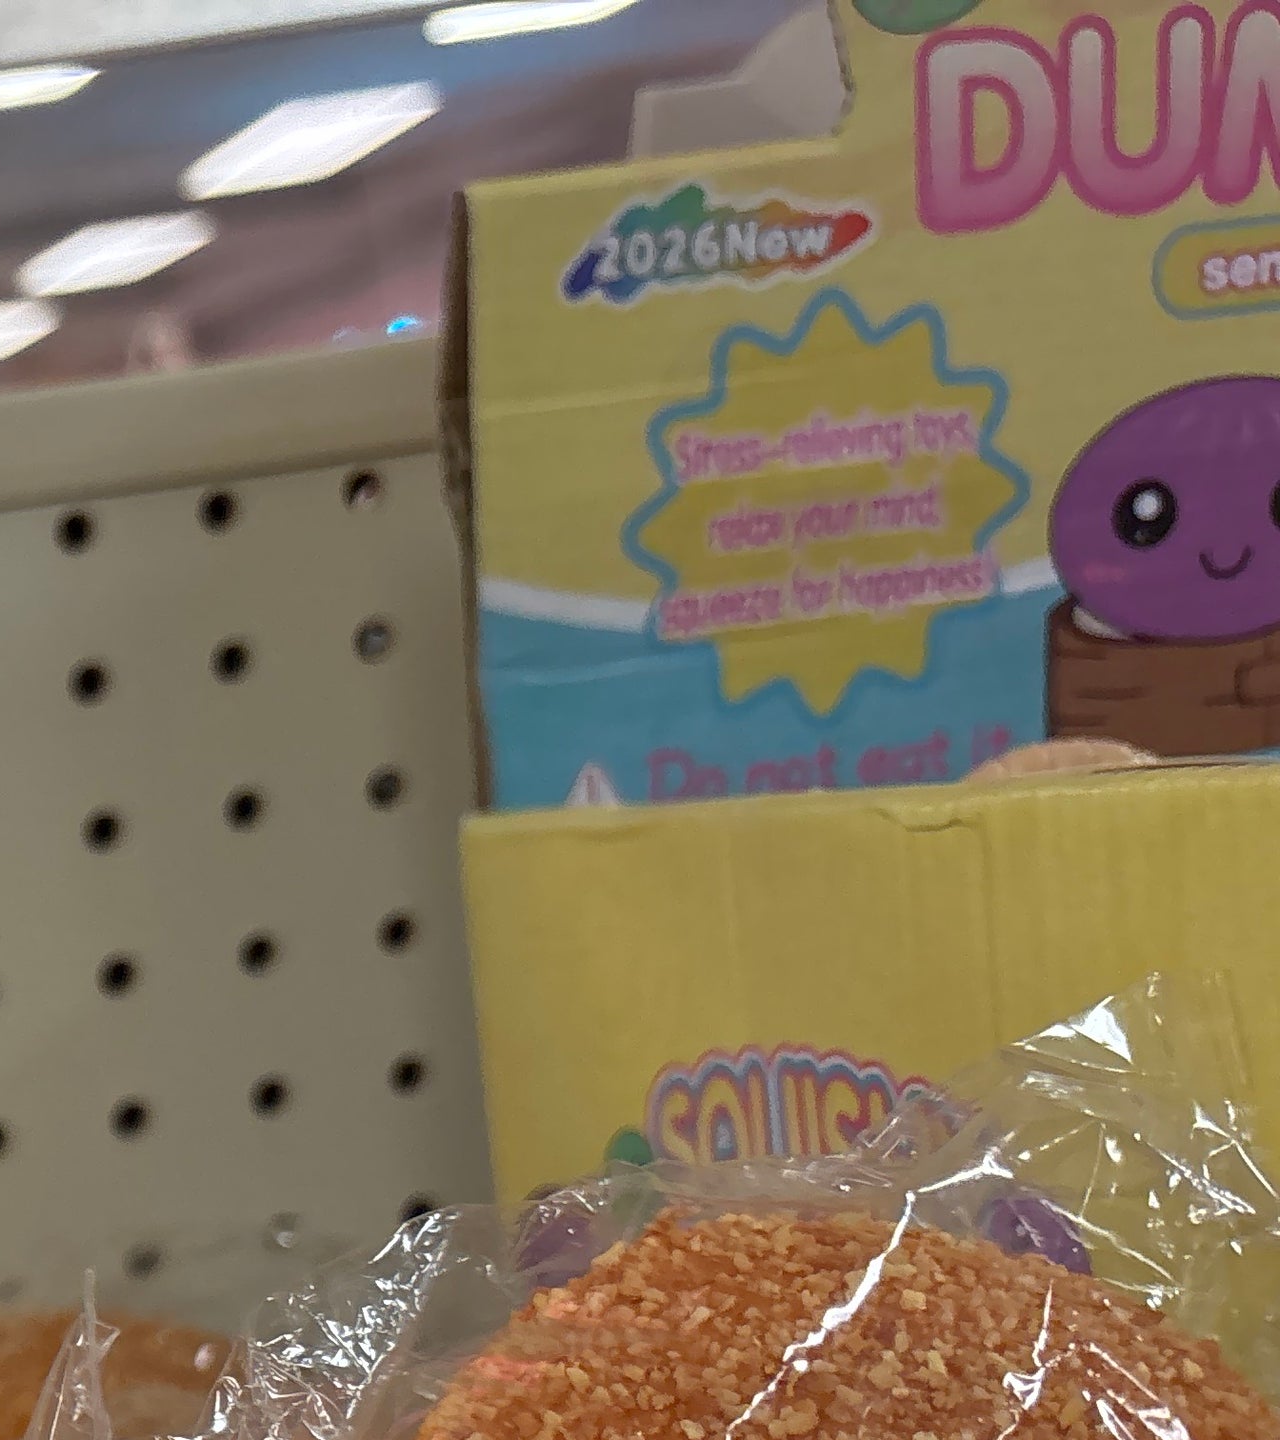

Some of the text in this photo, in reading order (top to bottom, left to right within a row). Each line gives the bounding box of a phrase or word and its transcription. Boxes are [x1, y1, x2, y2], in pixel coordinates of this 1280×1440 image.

[647, 746, 729, 802] Do
[744, 741, 838, 794] not
[856, 728, 950, 786] eat
